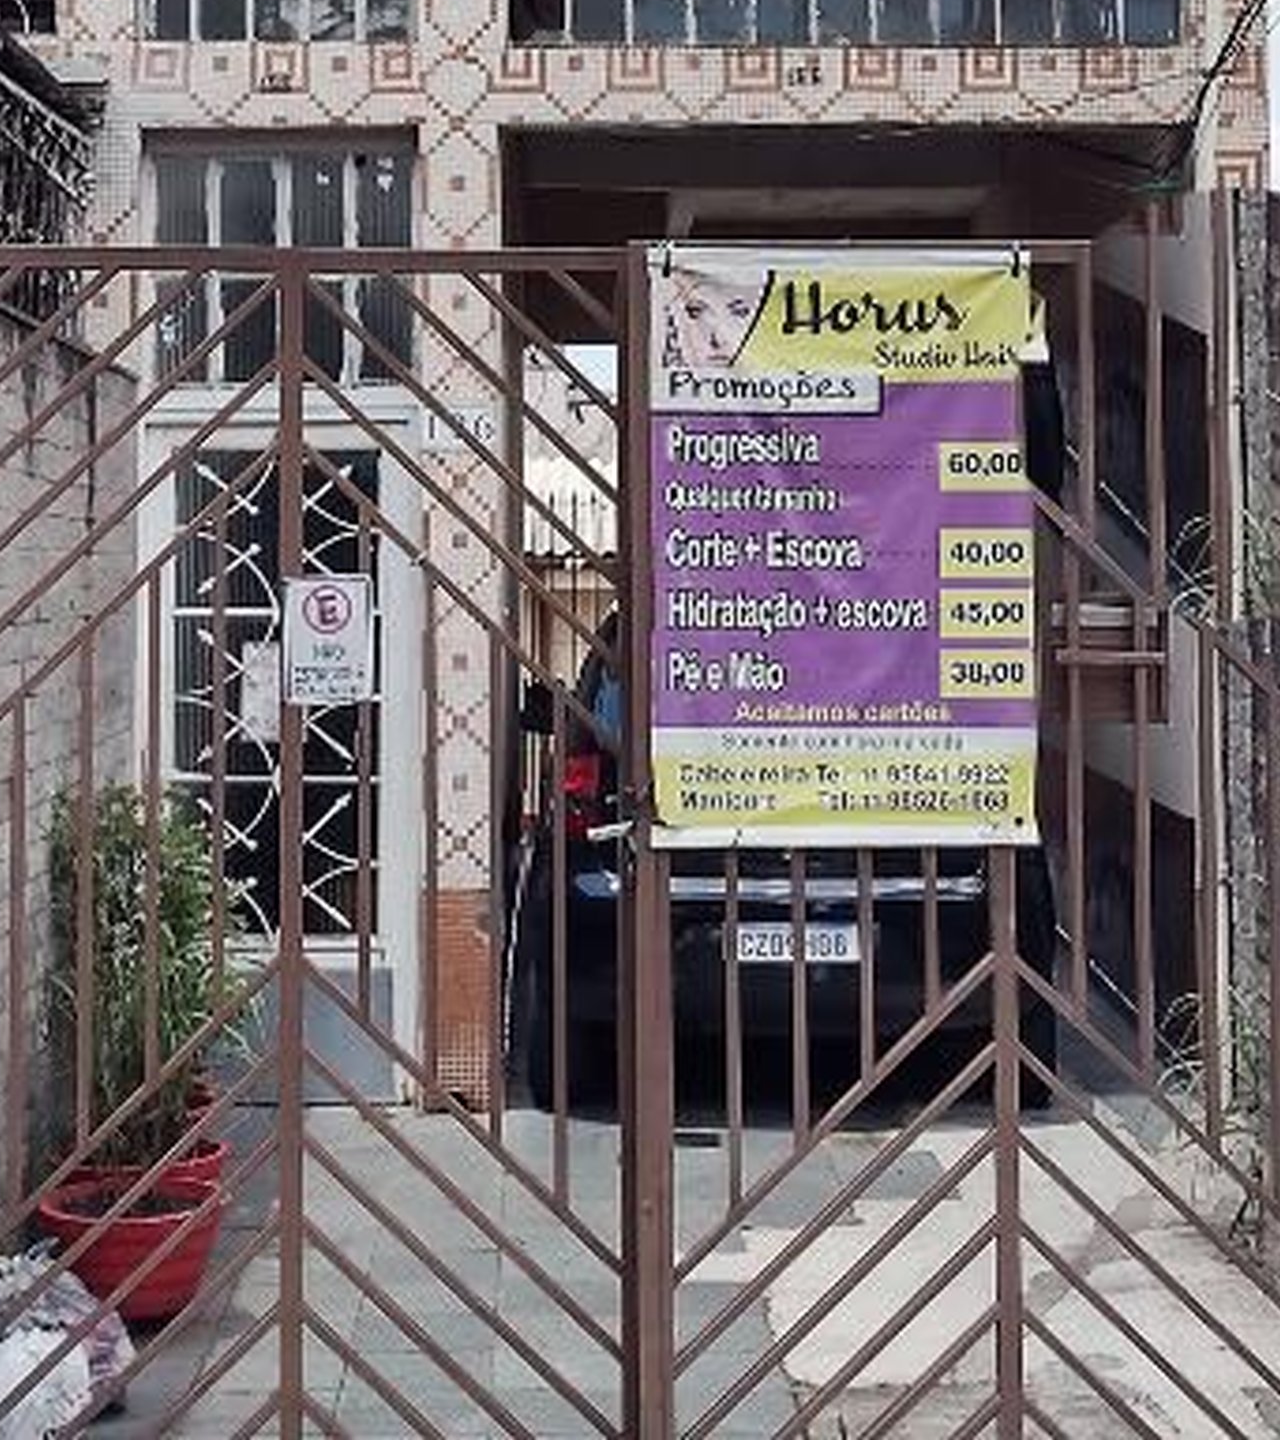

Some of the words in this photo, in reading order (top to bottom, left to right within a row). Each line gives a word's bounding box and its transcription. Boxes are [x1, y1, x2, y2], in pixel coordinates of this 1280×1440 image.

[781, 281, 967, 335] Horus
[874, 340, 957, 369] Studio
[669, 370, 857, 408] Promoções
[668, 426, 820, 469] Progressiva
[948, 451, 1022, 477] 60,00
[666, 529, 739, 568] Corte
[743, 539, 762, 561] +
[766, 531, 863, 568] Escova
[949, 541, 1025, 567] 40,00
[666, 589, 806, 637] Hidratação
[814, 600, 830, 623] +
[837, 596, 929, 629] escova
[949, 602, 1025, 629] 45,00
[666, 648, 699, 691] Pé
[706, 665, 725, 690] e
[728, 653, 786, 691] Mão
[734, 701, 860, 723] Aceitamos
